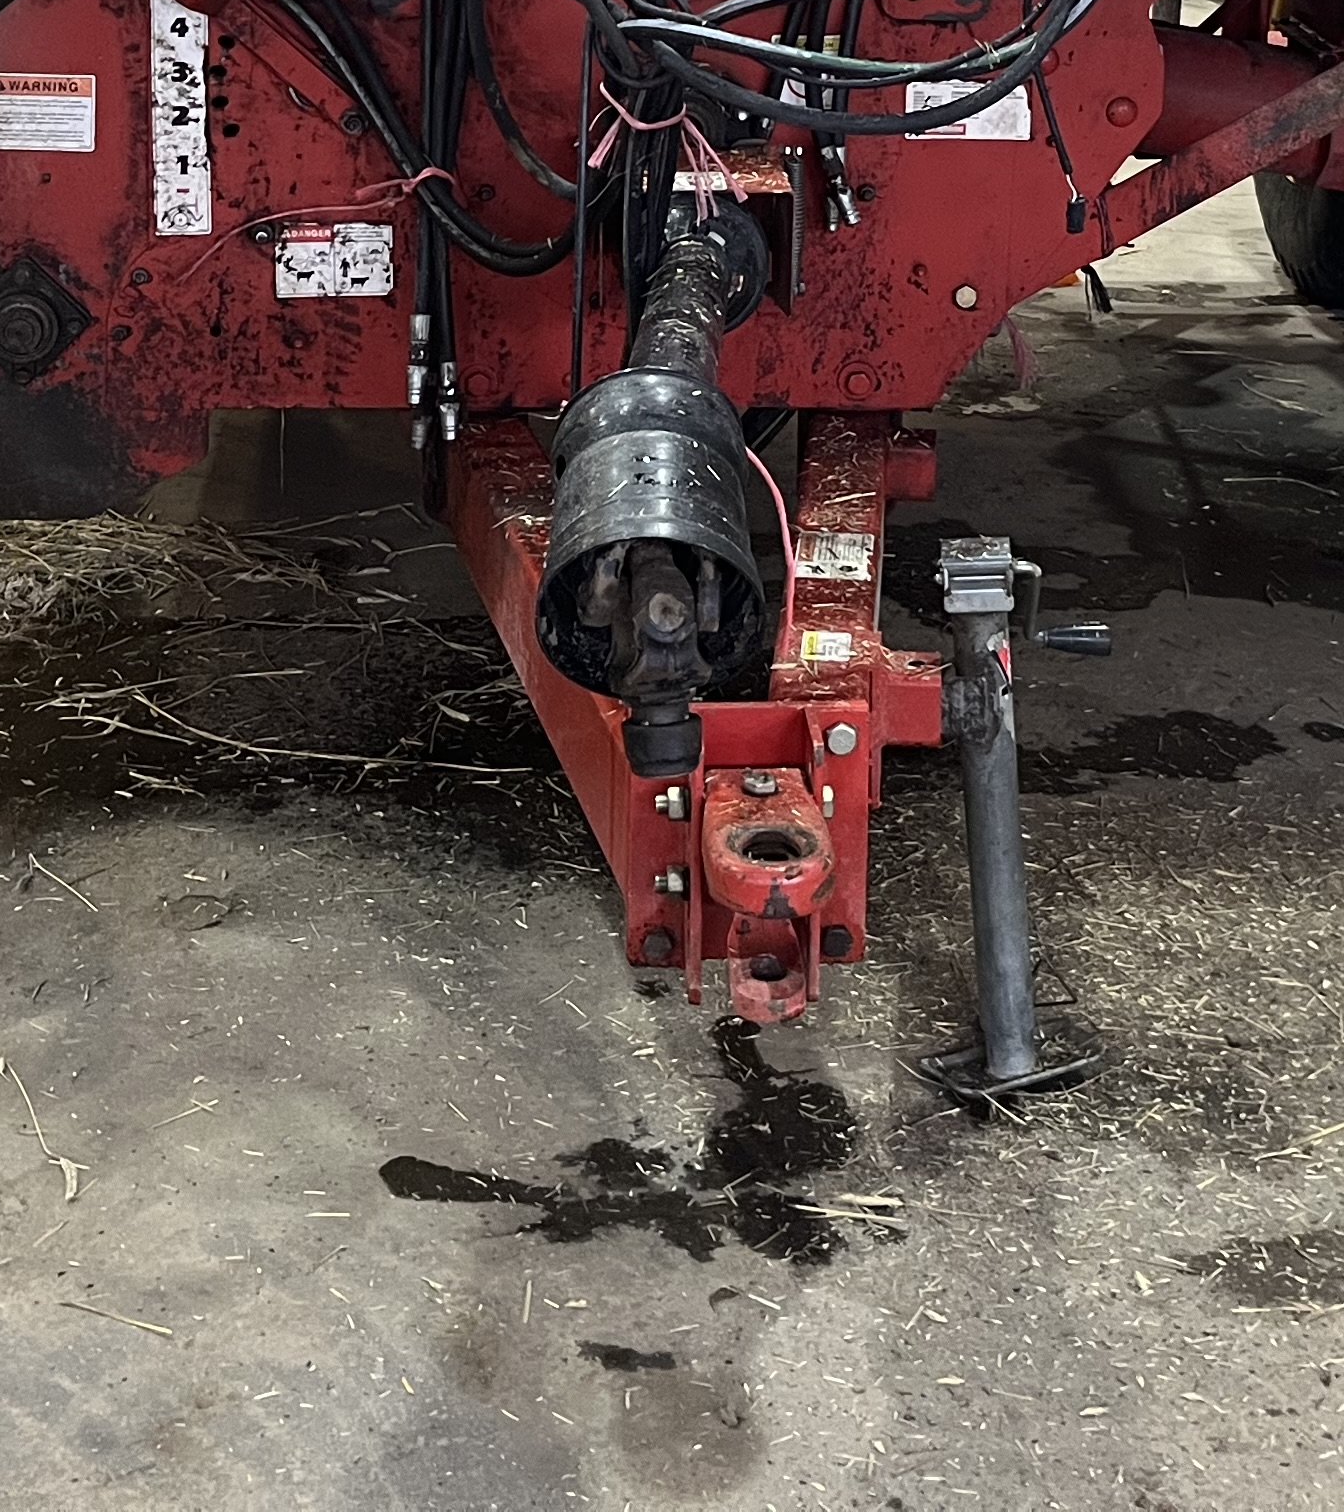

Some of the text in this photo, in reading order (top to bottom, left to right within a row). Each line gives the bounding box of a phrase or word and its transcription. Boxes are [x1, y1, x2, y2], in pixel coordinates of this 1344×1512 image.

[170, 17, 189, 38] 4
[170, 62, 189, 83] 3
[9, 81, 78, 93] WARNING
[171, 105, 191, 127] 2
[175, 155, 189, 175] 1
[291, 229, 331, 238] DANGER
